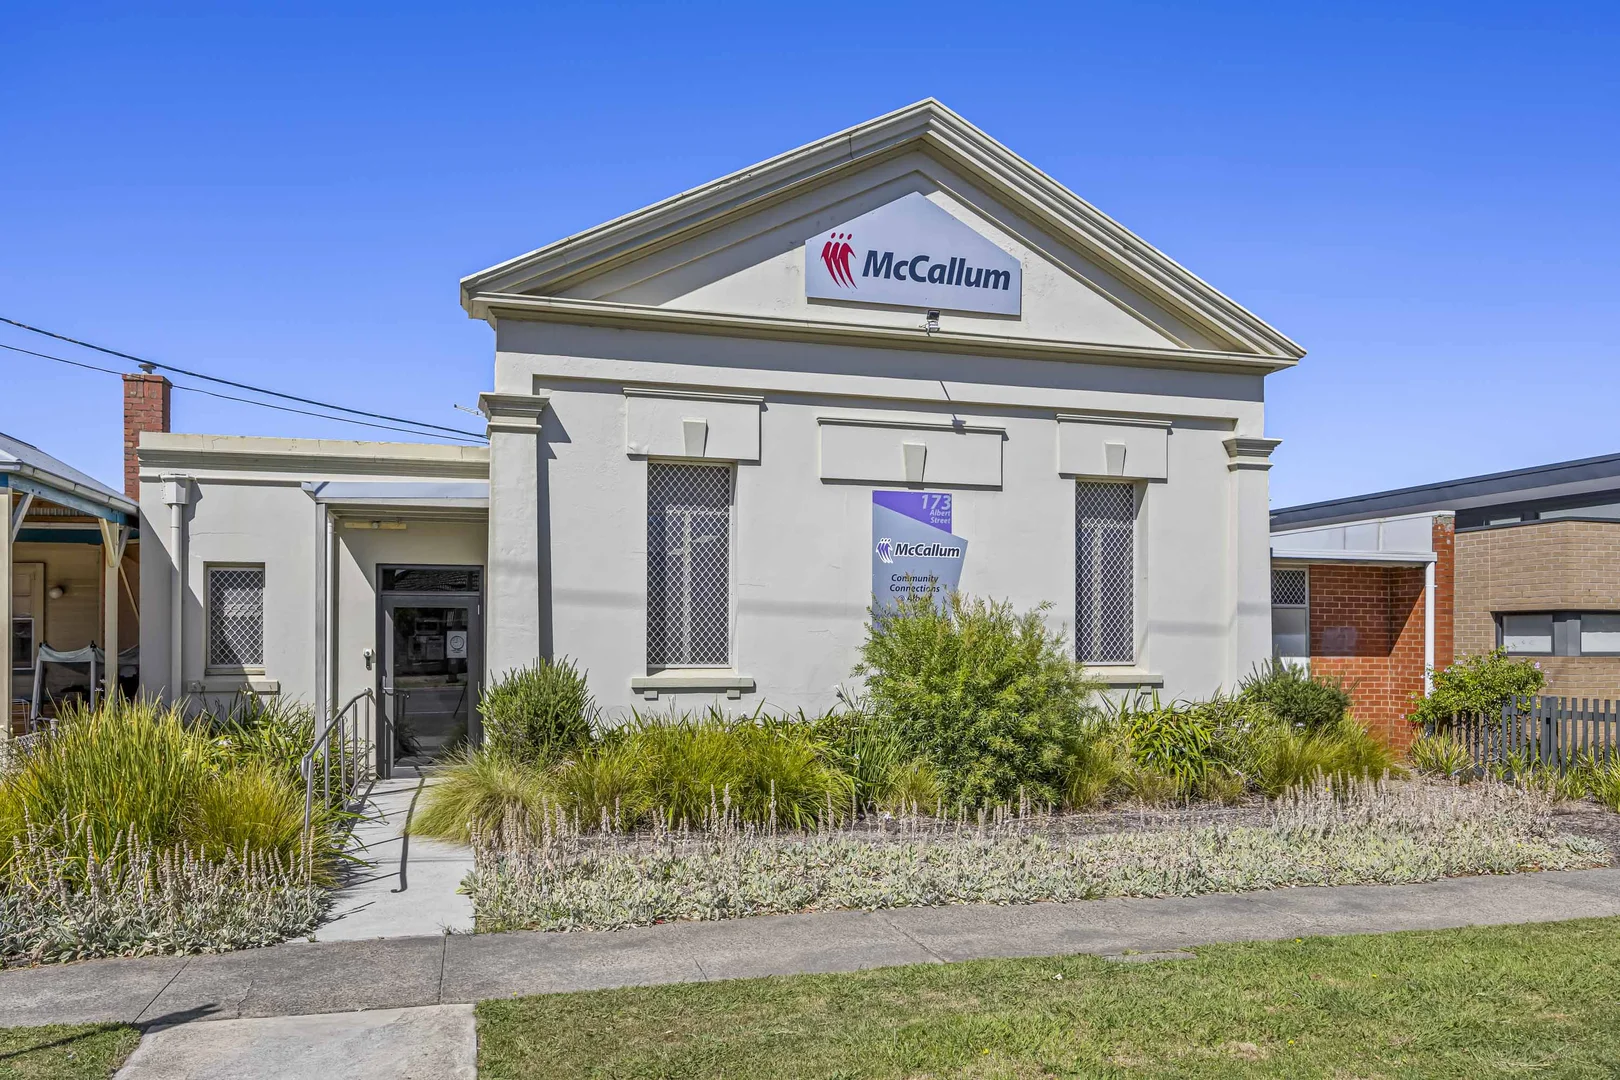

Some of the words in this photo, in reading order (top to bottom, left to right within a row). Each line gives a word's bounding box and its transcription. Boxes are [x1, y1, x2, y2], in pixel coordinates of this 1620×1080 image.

[862, 250, 1011, 291] McCallum
[921, 494, 951, 511] 173
[929, 509, 951, 517] Albert
[930, 516, 951, 524] Street
[894, 543, 960, 558] McCallum
